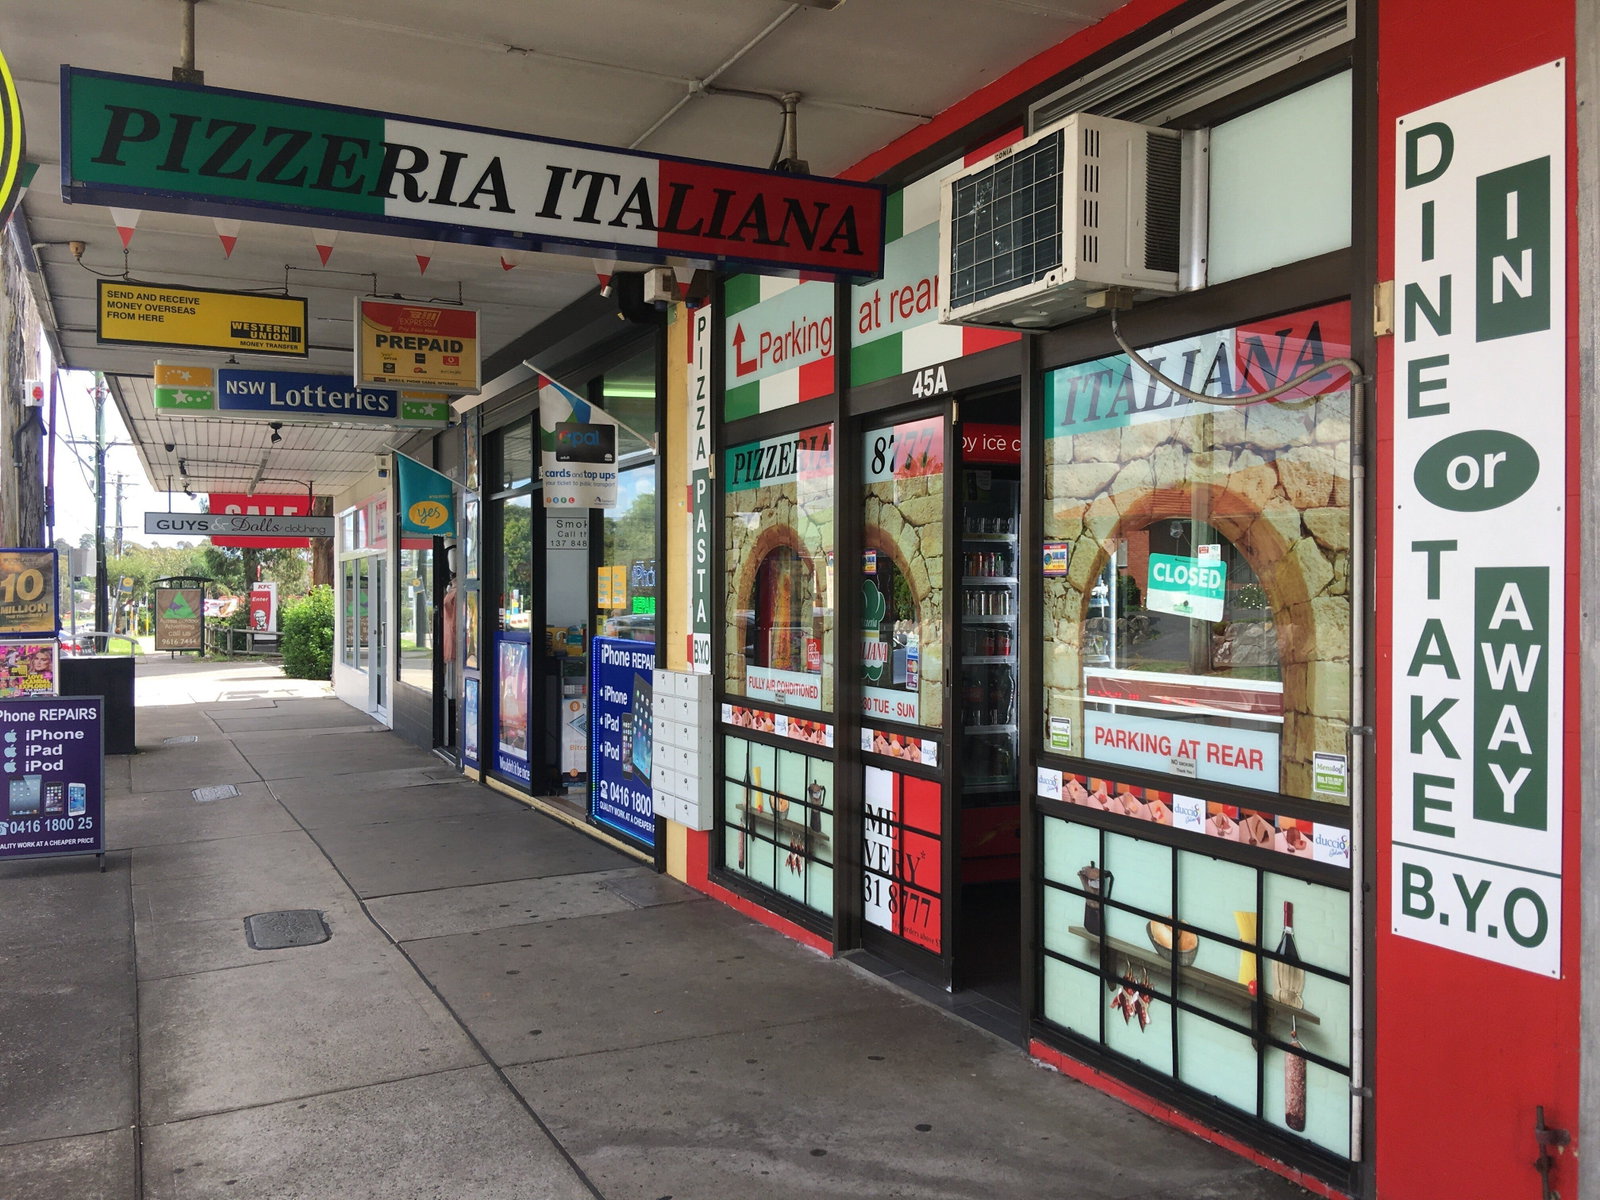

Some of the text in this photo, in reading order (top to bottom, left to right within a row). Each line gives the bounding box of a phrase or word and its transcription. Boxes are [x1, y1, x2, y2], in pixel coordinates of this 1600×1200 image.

[91, 104, 864, 256] PIZZERIA ITALIANA
[1492, 190, 1532, 304] IN
[1404, 121, 1454, 419] DINE
[107, 290, 200, 306] SEND AND RECEIVE
[107, 301, 196, 315] MONEY OVERSEAS
[859, 275, 939, 334] at rear
[107, 311, 164, 323] FROM HERE
[231, 322, 290, 333] WESTERN
[249, 331, 290, 341] UNION
[240, 340, 299, 350] MONEY TRANSFER
[375, 334, 464, 353] PREPAID
[760, 315, 833, 369] Parking
[912, 366, 948, 398] 45A
[1061, 320, 1332, 426] ITALIANA
[226, 380, 389, 412] NSW Lotteries
[696, 315, 706, 461] PIZZA
[983, 433, 1007, 451] ice
[732, 432, 832, 485] PIZZERIA
[545, 468, 571, 478] cards
[583, 470, 598, 480] top
[599, 472, 616, 481] ups
[1446, 451, 1506, 491] or
[417, 506, 441, 524] yes
[156, 519, 209, 531] GUYS
[231, 517, 282, 532] Dolls
[284, 523, 326, 535] clothing
[557, 530, 576, 538] Call
[696, 479, 707, 623] PASTA
[0, 568, 44, 603] 10
[1153, 562, 1221, 589] CLOSED
[601, 644, 630, 668] iPhone
[604, 685, 628, 705] iPhone
[749, 675, 766, 690] FULLY
[766, 679, 775, 692] AIR
[777, 680, 819, 699] CONDITIONED
[1407, 540, 1461, 838] TAKE
[873, 698, 890, 714] TUE
[896, 702, 915, 719] SUN
[1480, 582, 1541, 815] AWAY
[0, 707, 97, 722] hone REPAIRS
[604, 713, 620, 732] iPad
[26, 729, 85, 741] iPhone
[25, 744, 63, 756] iPad
[604, 741, 620, 761] iPod
[1095, 726, 1172, 757] PARKING
[1177, 738, 1201, 760] AT
[1207, 742, 1263, 771] REAR
[25, 759, 64, 772] iPod
[600, 800, 614, 814] QUALITY
[610, 782, 651, 817] 0416 1800
[10, 816, 93, 834] 0416 1800 25
[17, 841, 35, 849] WORK
[49, 838, 76, 846] CHEAPER
[1315, 834, 1346, 850] duccio
[864, 874, 931, 929] 31 8777
[1401, 862, 1549, 949] B.Y.O
